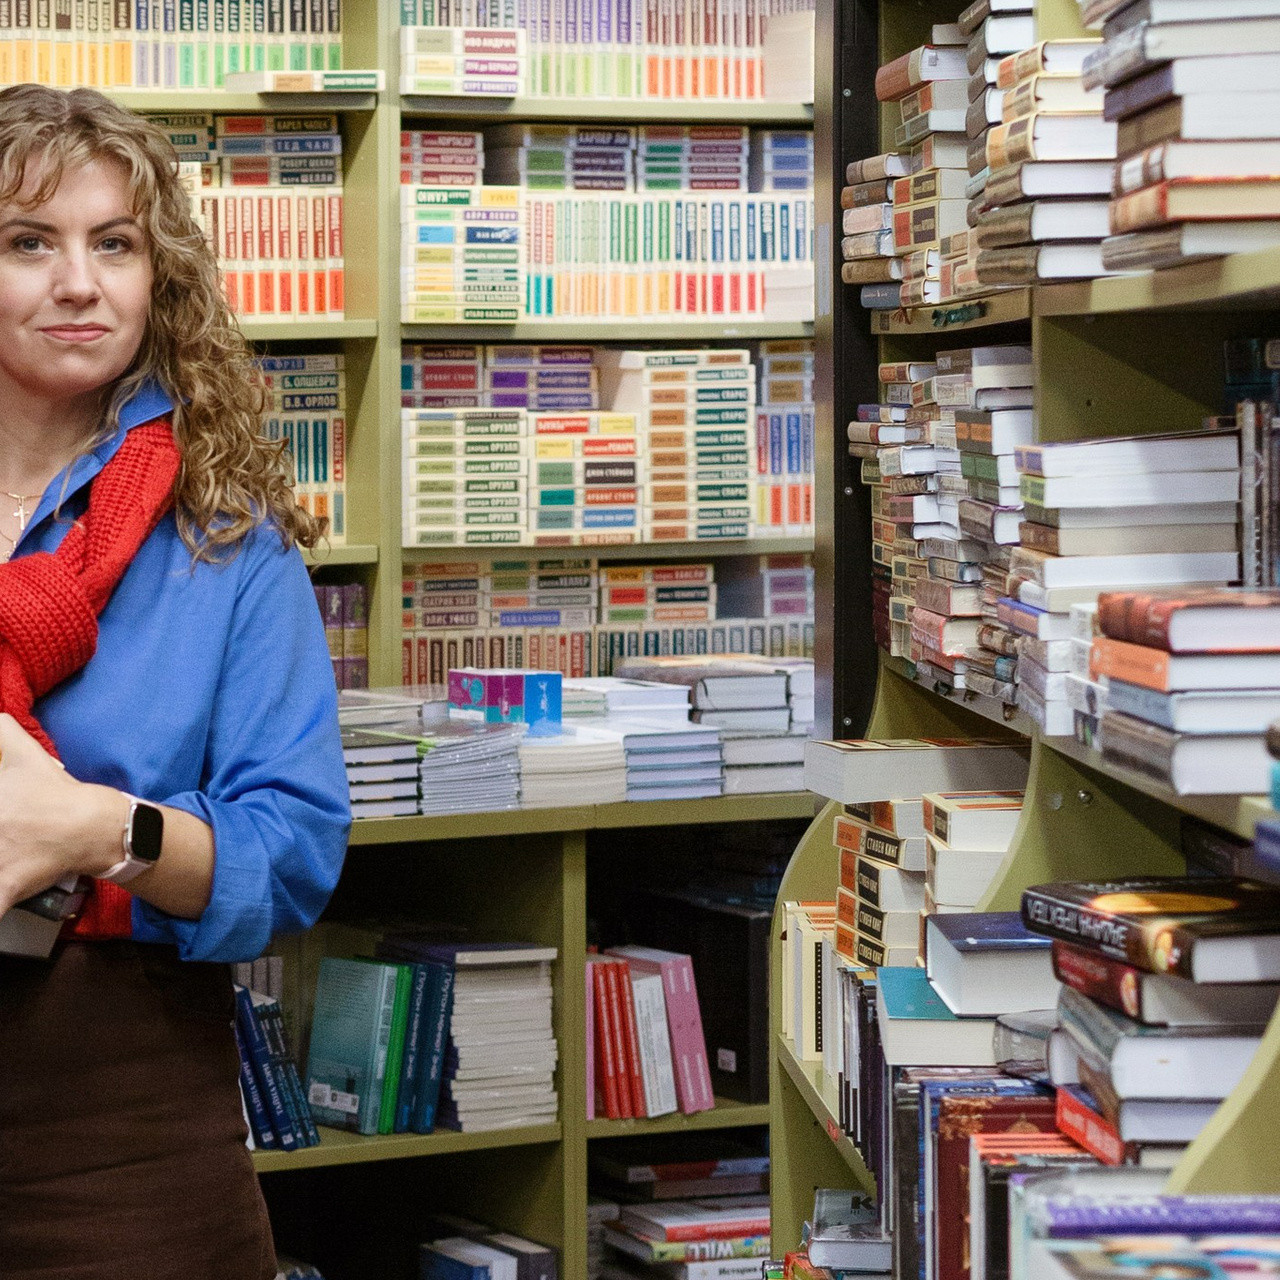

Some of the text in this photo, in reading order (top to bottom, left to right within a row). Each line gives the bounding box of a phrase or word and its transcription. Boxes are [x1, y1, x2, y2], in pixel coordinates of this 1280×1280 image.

[182, 0, 193, 31] АРТУР
[198, 0, 208, 31] АРТУР
[229, 0, 240, 31] АРТУР
[276, 139, 330, 151] ТЕД ЧАН
[418, 190, 448, 202] КАМЮ
[465, 211, 517, 221] АЙРА ЛЕВИН
[284, 375, 336, 387] Б. ОЛШЕВРИ
[284, 395, 337, 408] В.В. ОРЛОВ
[866, 837, 899, 858] СТИВЕН КИНГ
[859, 909, 883, 933] СТИВЕН КИНГ
[858, 942, 883, 964] СТИВЕН КИНГ
[270, 1086, 284, 1116] ТАЙНА
[687, 1242, 735, 1258] WILL
